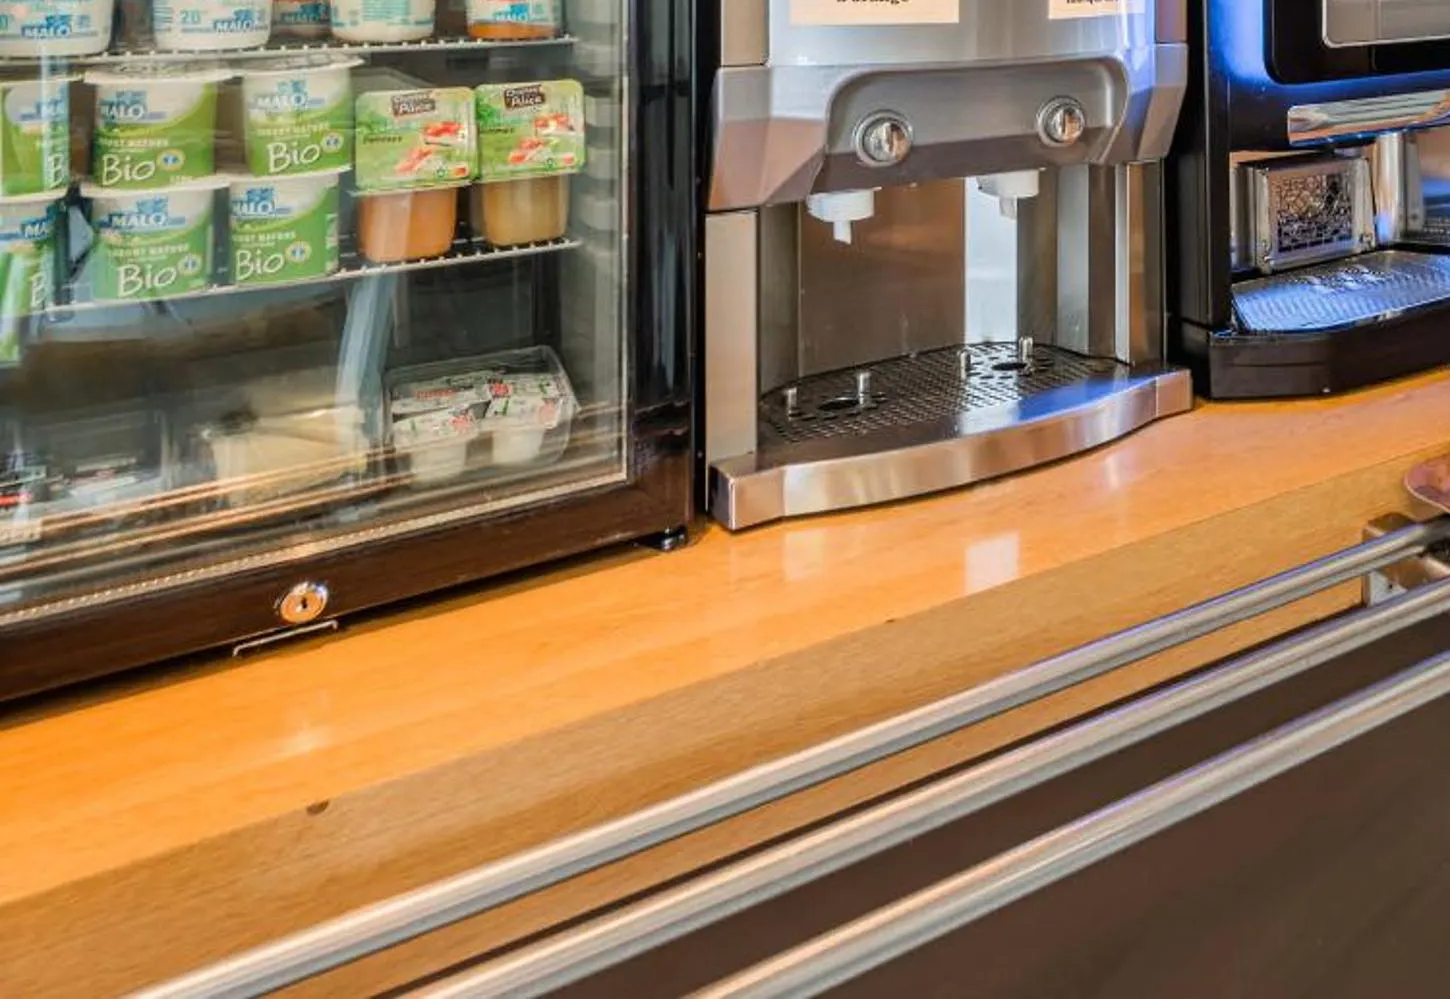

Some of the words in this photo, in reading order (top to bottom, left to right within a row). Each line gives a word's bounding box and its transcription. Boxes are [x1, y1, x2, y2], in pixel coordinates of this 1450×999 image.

[102, 153, 156, 187] Bio
[266, 141, 320, 173] Bio
[112, 211, 167, 227] MALO
[117, 262, 177, 298] Bio
[235, 249, 285, 280] Bio
